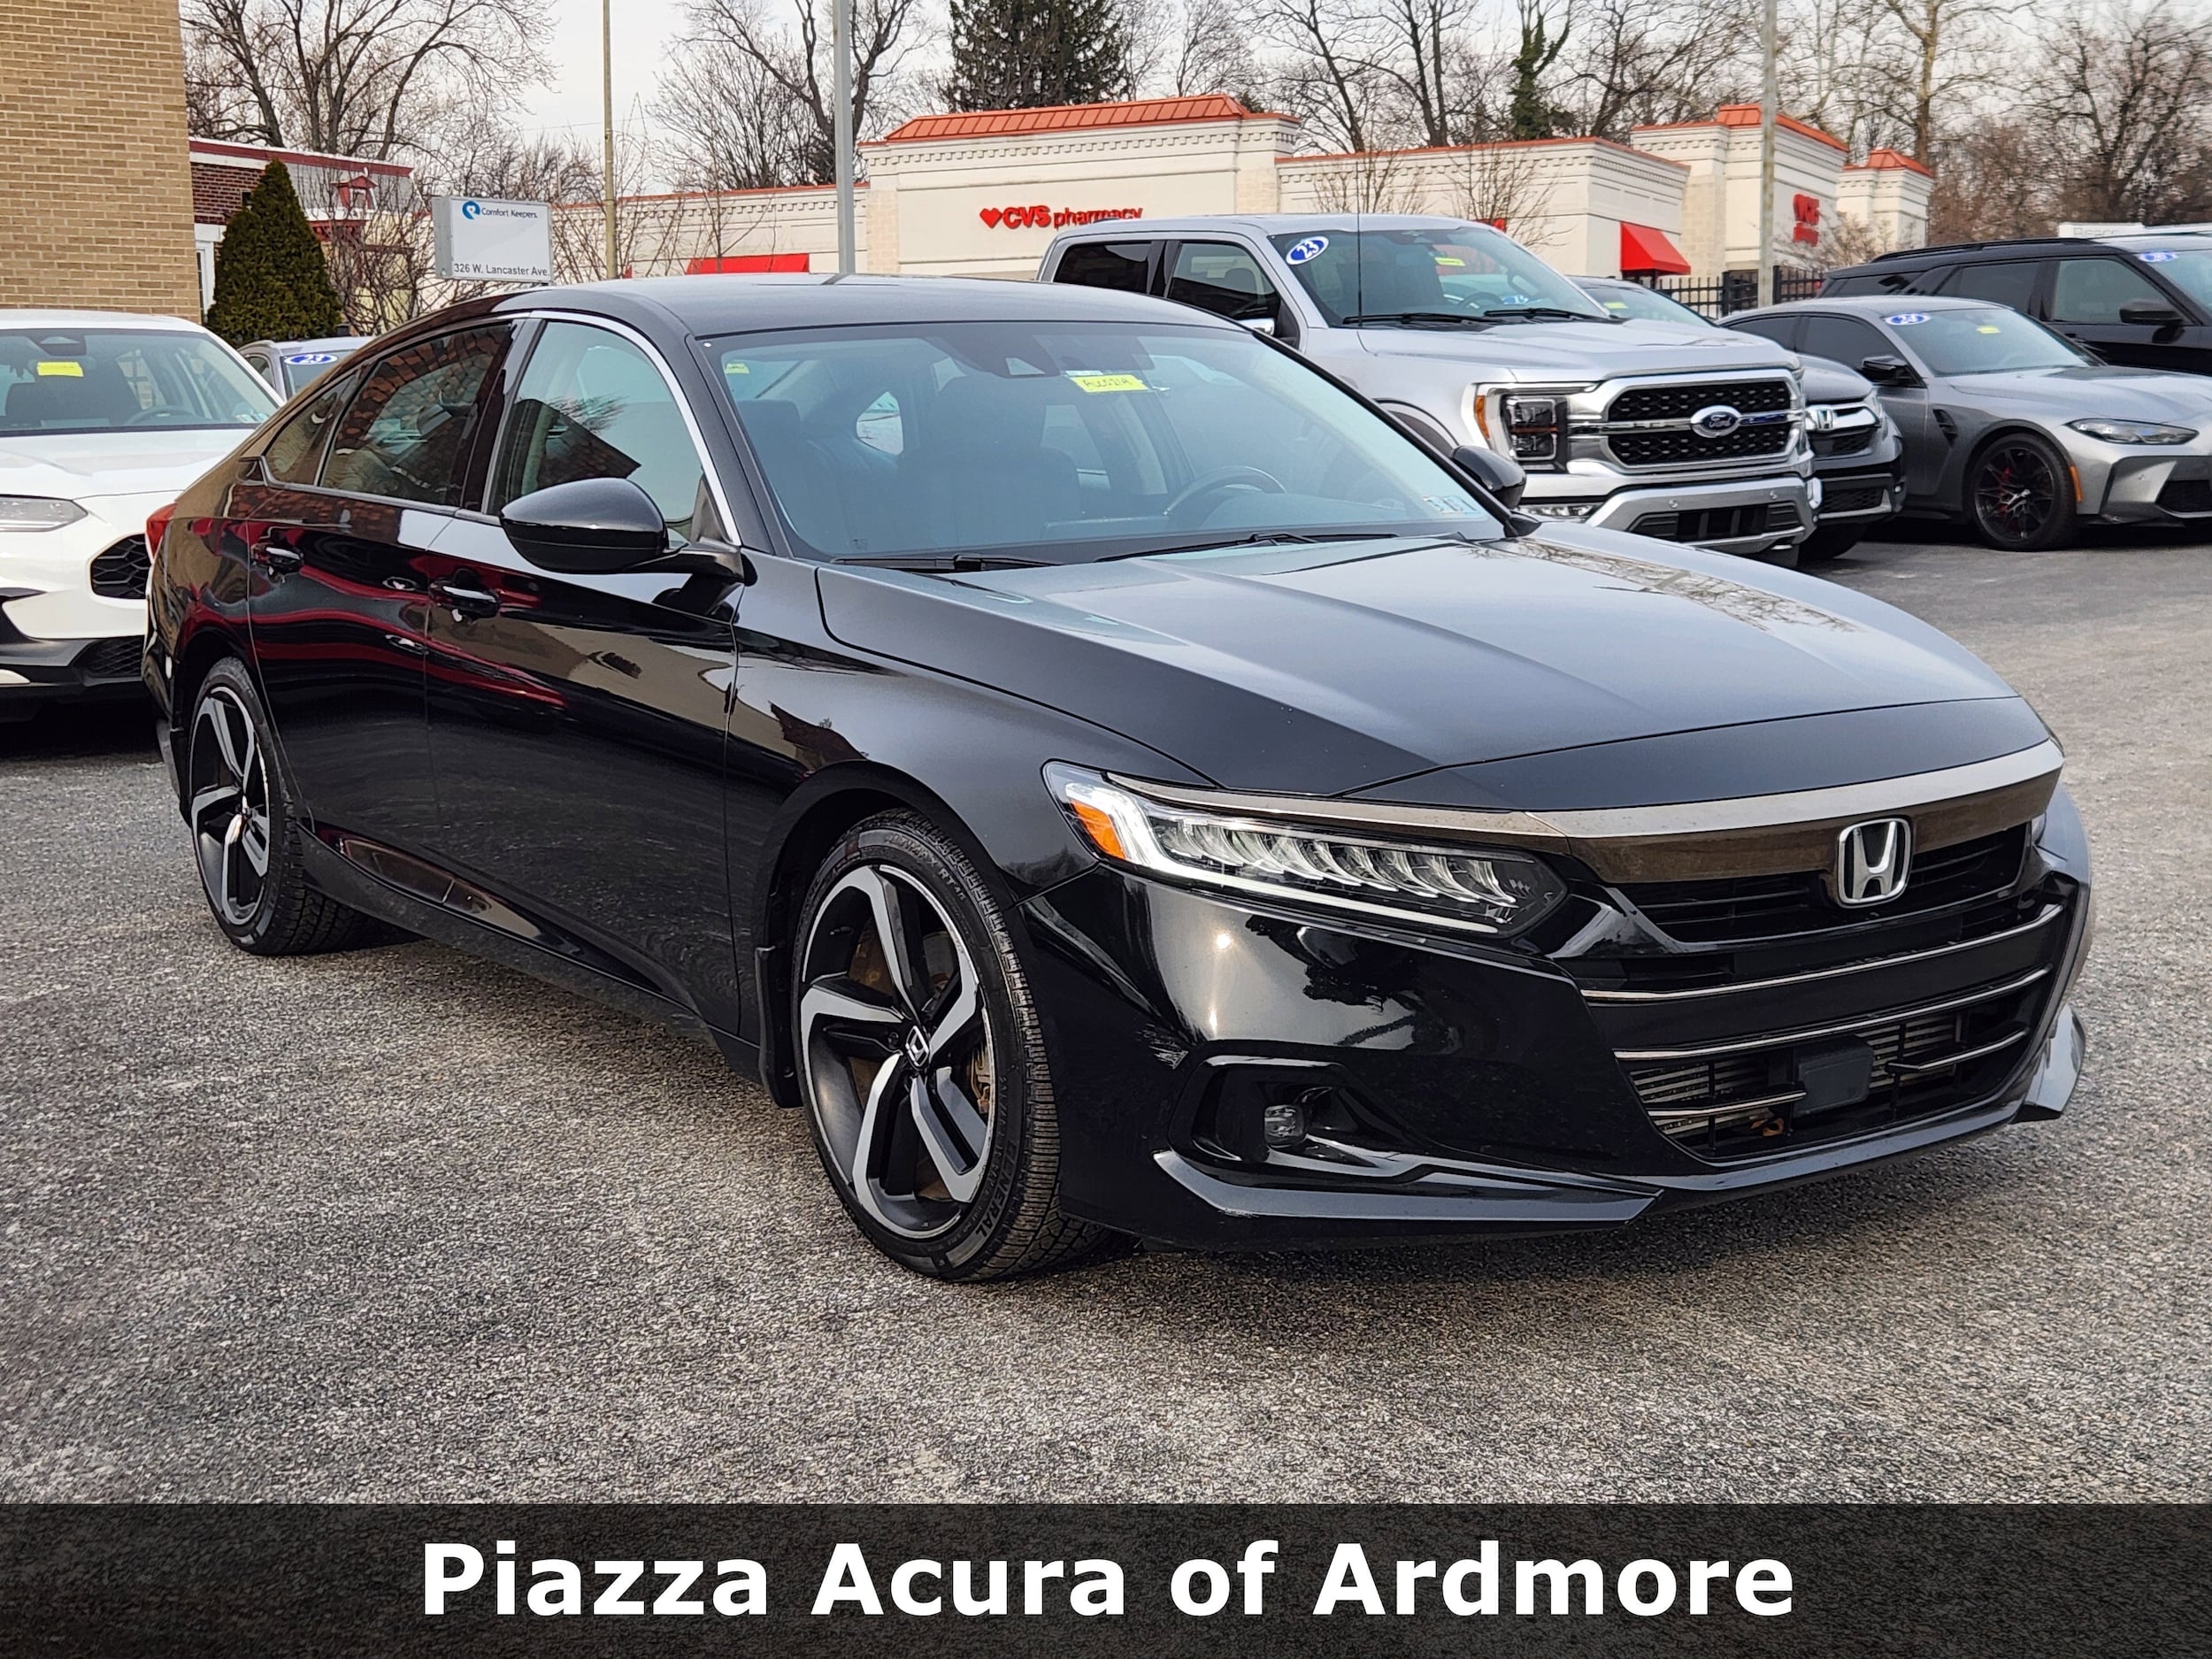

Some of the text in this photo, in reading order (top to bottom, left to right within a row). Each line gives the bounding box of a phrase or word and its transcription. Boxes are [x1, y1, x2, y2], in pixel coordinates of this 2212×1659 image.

[481, 207, 509, 217] Comfort
[1002, 205, 1142, 230] CVS pharmacy
[1297, 241, 1319, 258] 23
[454, 264, 470, 273] 326
[472, 265, 483, 273] W.
[486, 265, 528, 275] Lancaster
[1709, 414, 1732, 428] Ford
